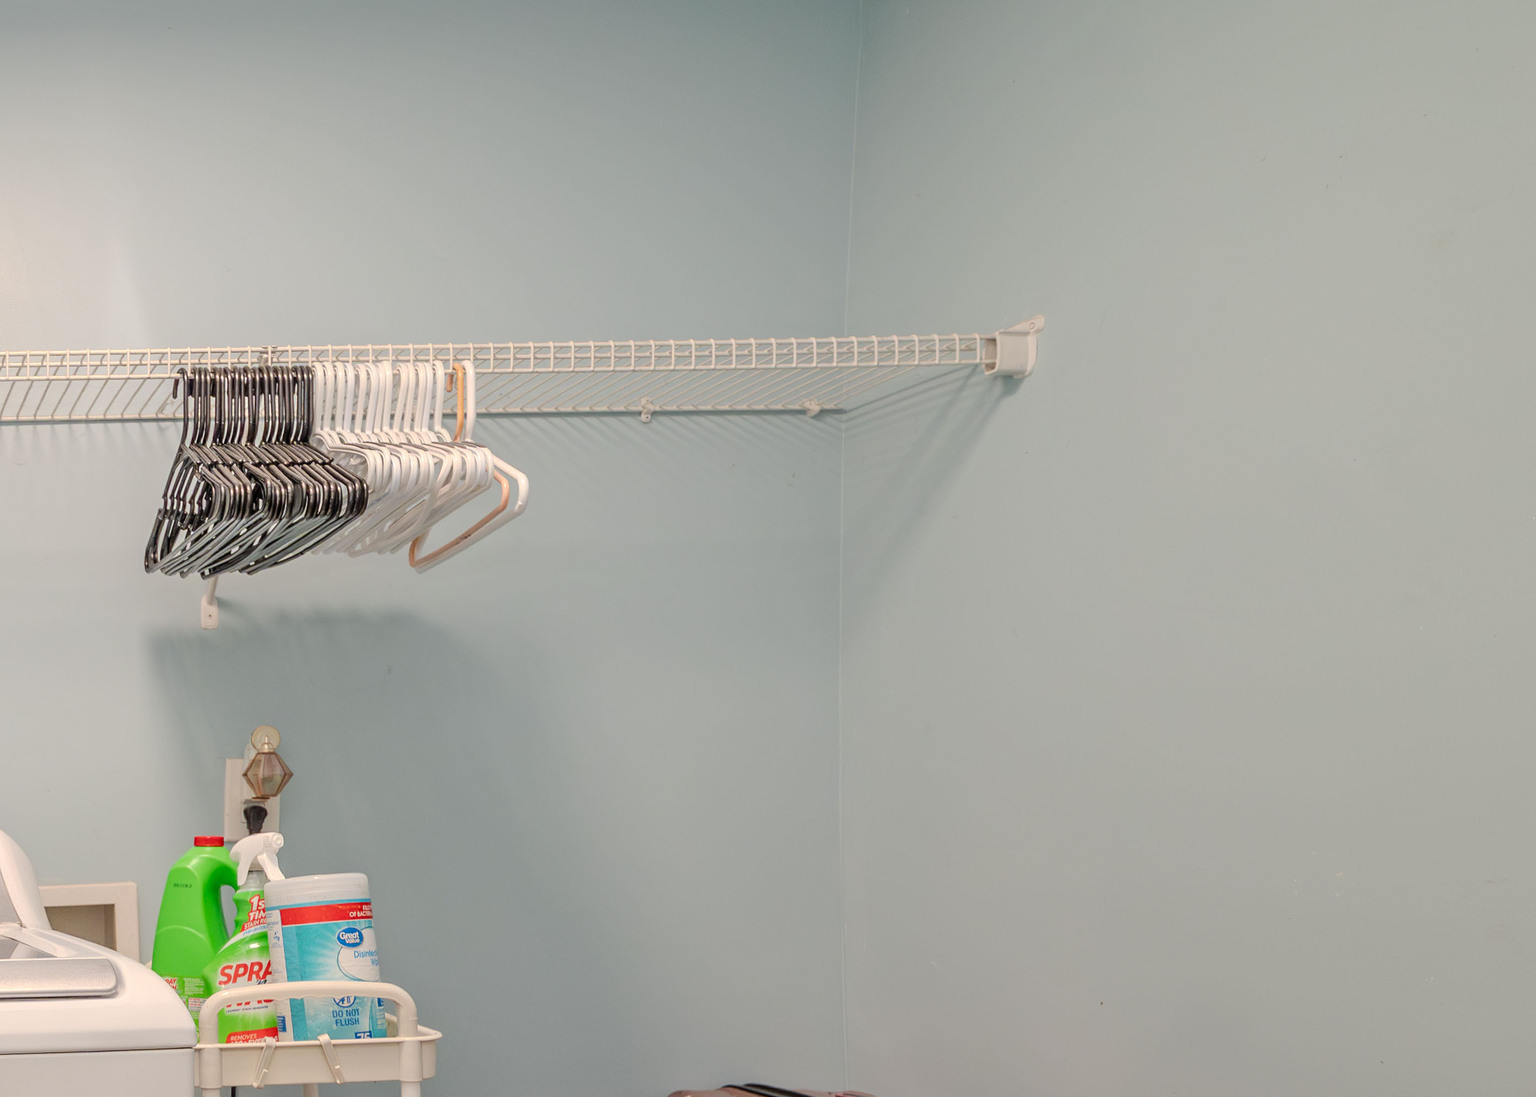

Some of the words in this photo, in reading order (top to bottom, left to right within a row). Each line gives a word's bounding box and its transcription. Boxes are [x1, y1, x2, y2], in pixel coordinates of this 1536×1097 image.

[250, 895, 265, 911] 1S
[249, 910, 266, 921] TIM
[244, 920, 260, 930] STAIN
[340, 932, 359, 940] Great
[218, 960, 272, 986] SPRA
[332, 1010, 343, 1018] DO
[346, 1008, 360, 1016] NOT
[335, 1018, 360, 1026] FLUSH
